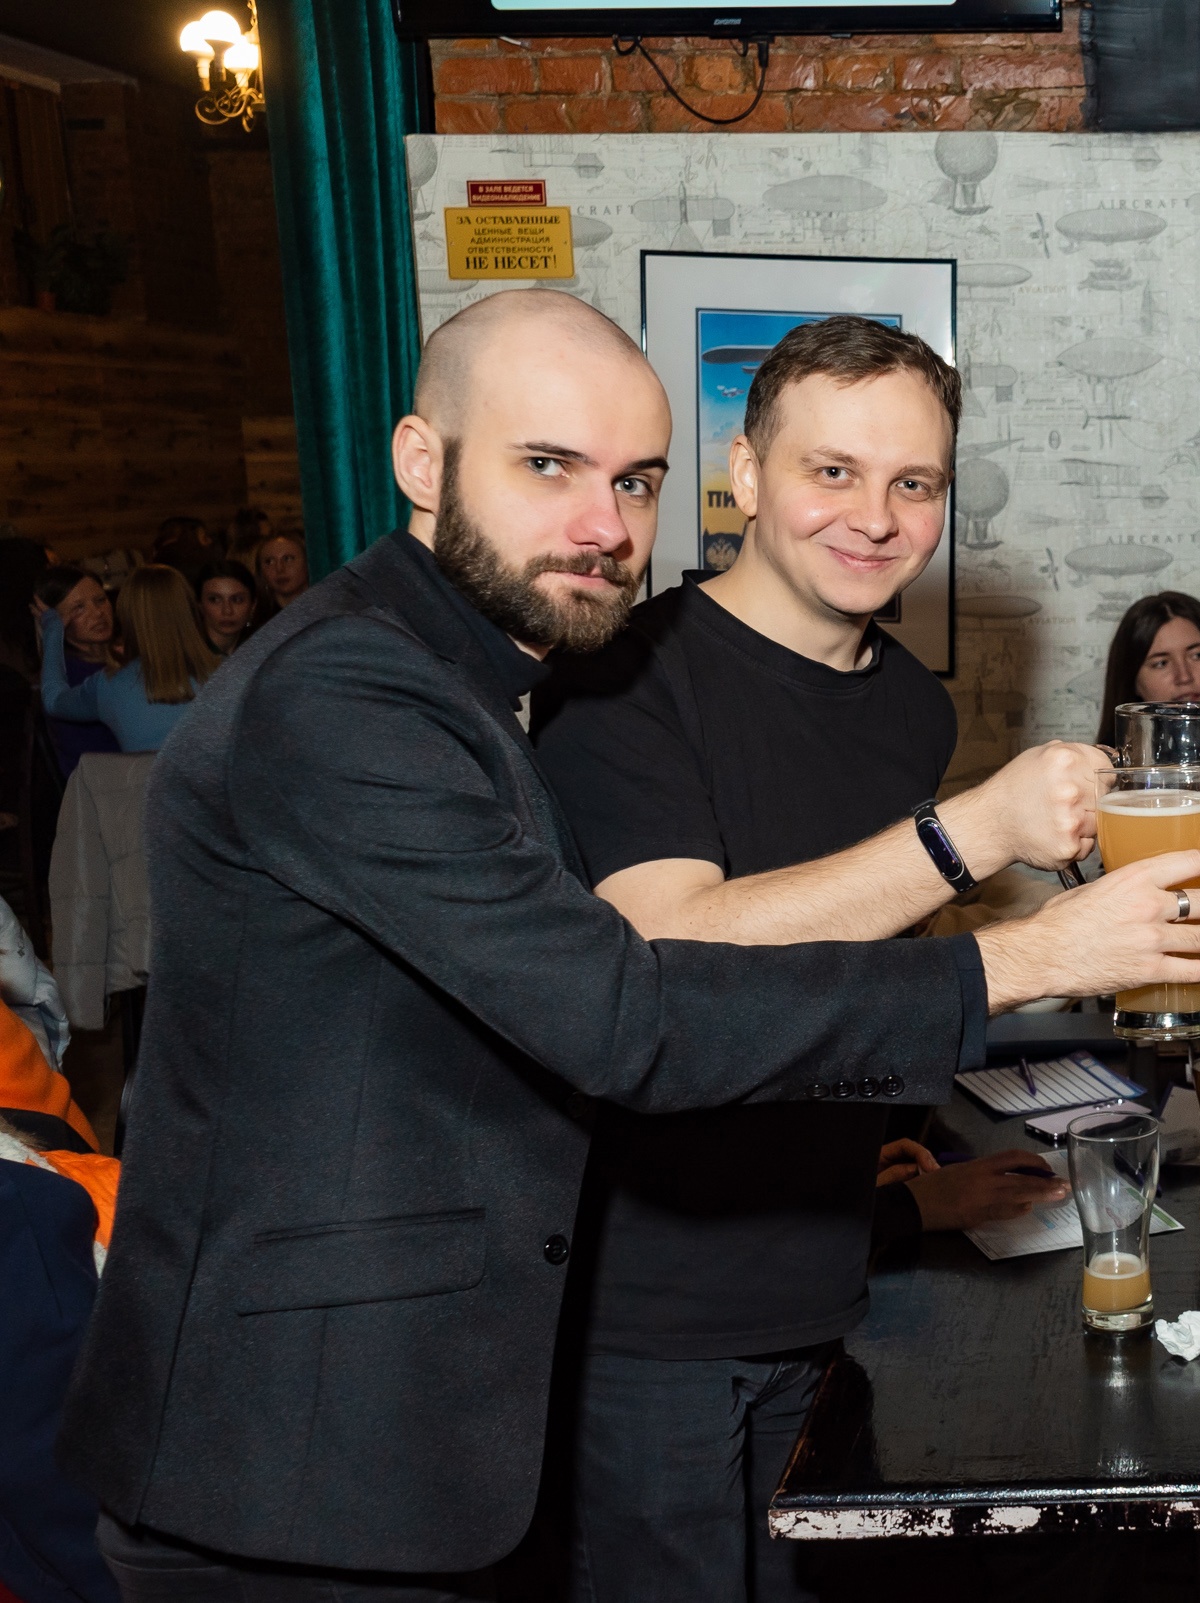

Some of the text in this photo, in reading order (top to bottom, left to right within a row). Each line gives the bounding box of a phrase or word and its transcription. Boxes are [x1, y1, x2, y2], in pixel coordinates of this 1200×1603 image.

[576, 204, 635, 216] CRAFT
[456, 215, 561, 225] ЗА ОСТАВЛЕННЫЕ
[474, 227, 545, 236] ЦЕННЫЕ ВЕЩИ
[470, 237, 551, 245] АДМИНИСТРАЦИЯ
[467, 246, 554, 255] ОТВЕТСТВЕННОСТИ
[465, 254, 557, 270] НЕ НЕСЕТ!
[707, 490, 736, 508] ПИ
